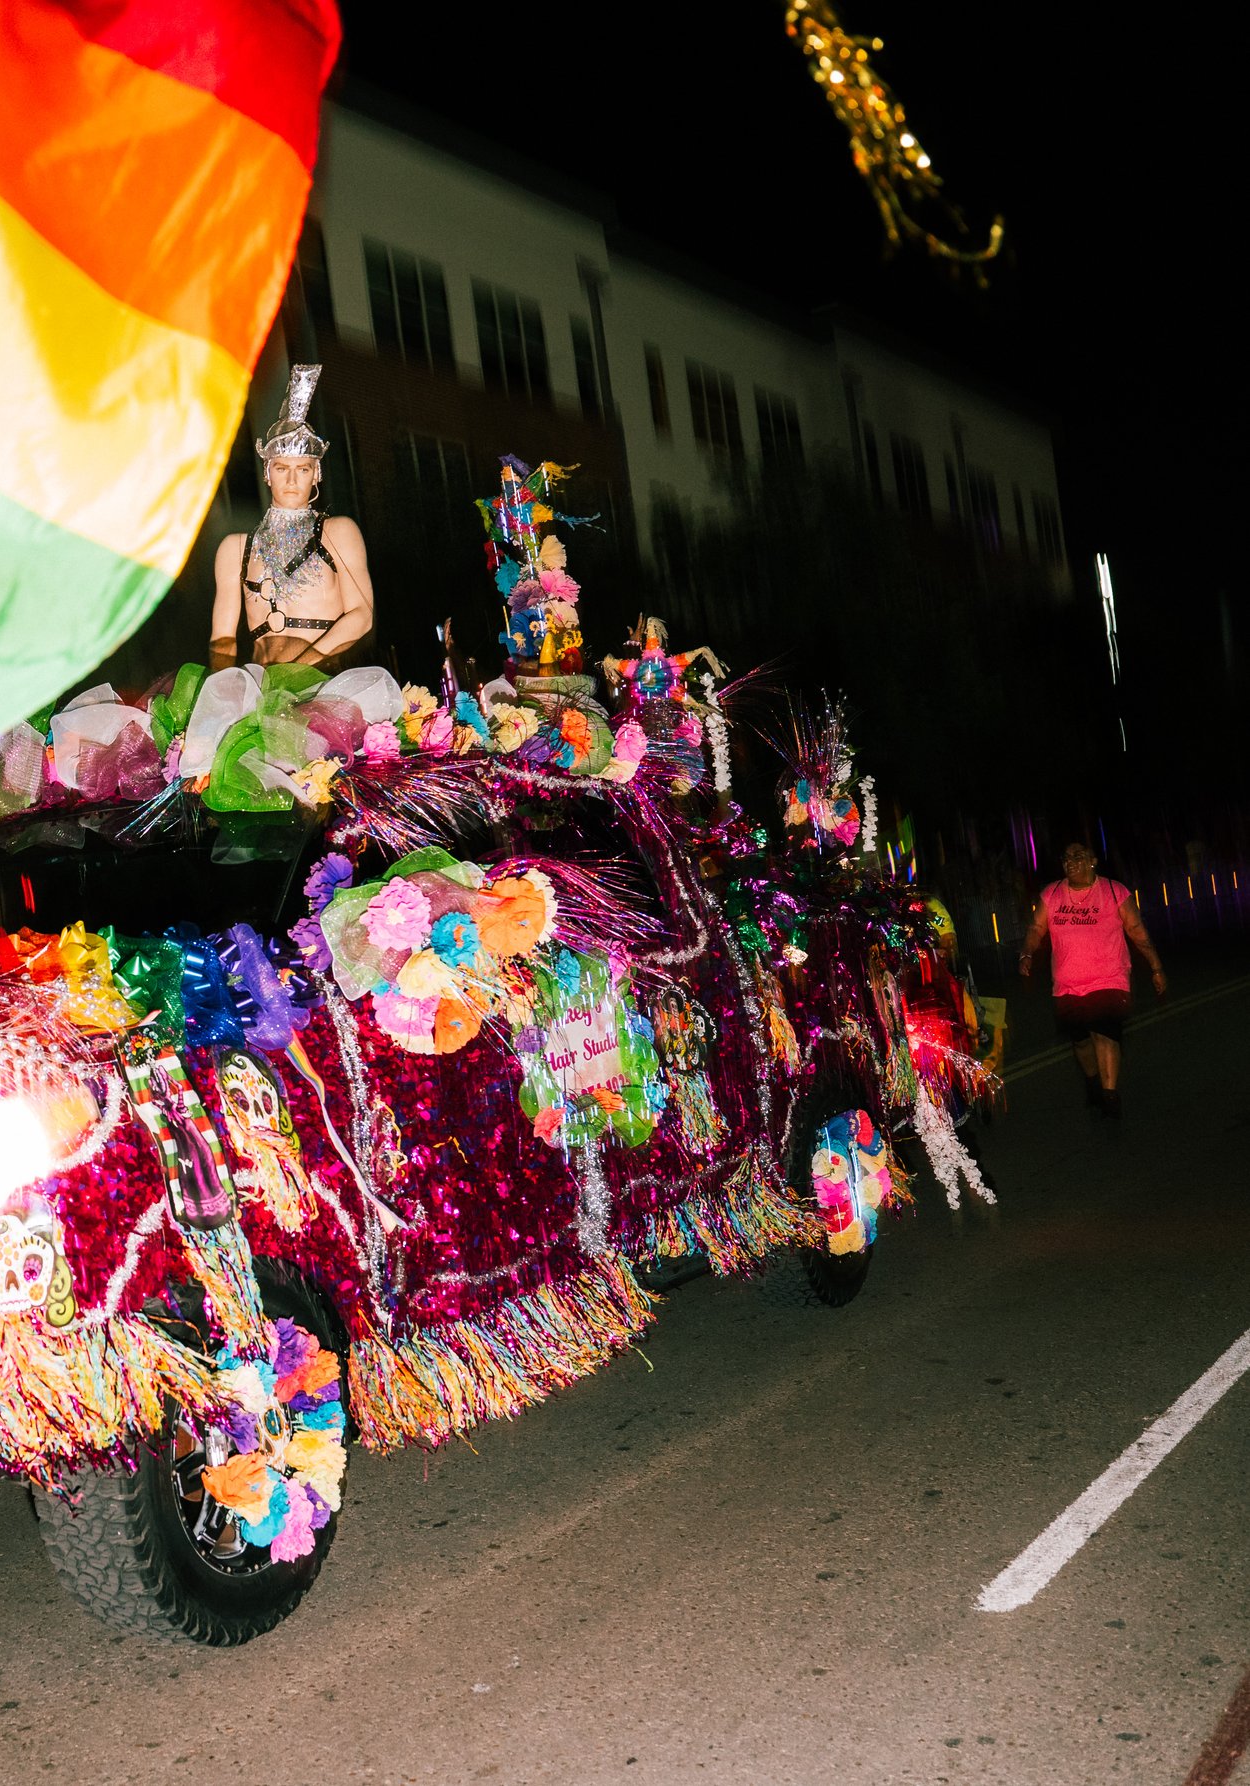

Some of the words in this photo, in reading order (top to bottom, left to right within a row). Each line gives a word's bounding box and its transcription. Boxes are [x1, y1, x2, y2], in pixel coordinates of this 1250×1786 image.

[1054, 904, 1100, 917] Mikey's
[1070, 915, 1098, 926] Studio
[543, 1047, 578, 1072] Hair
